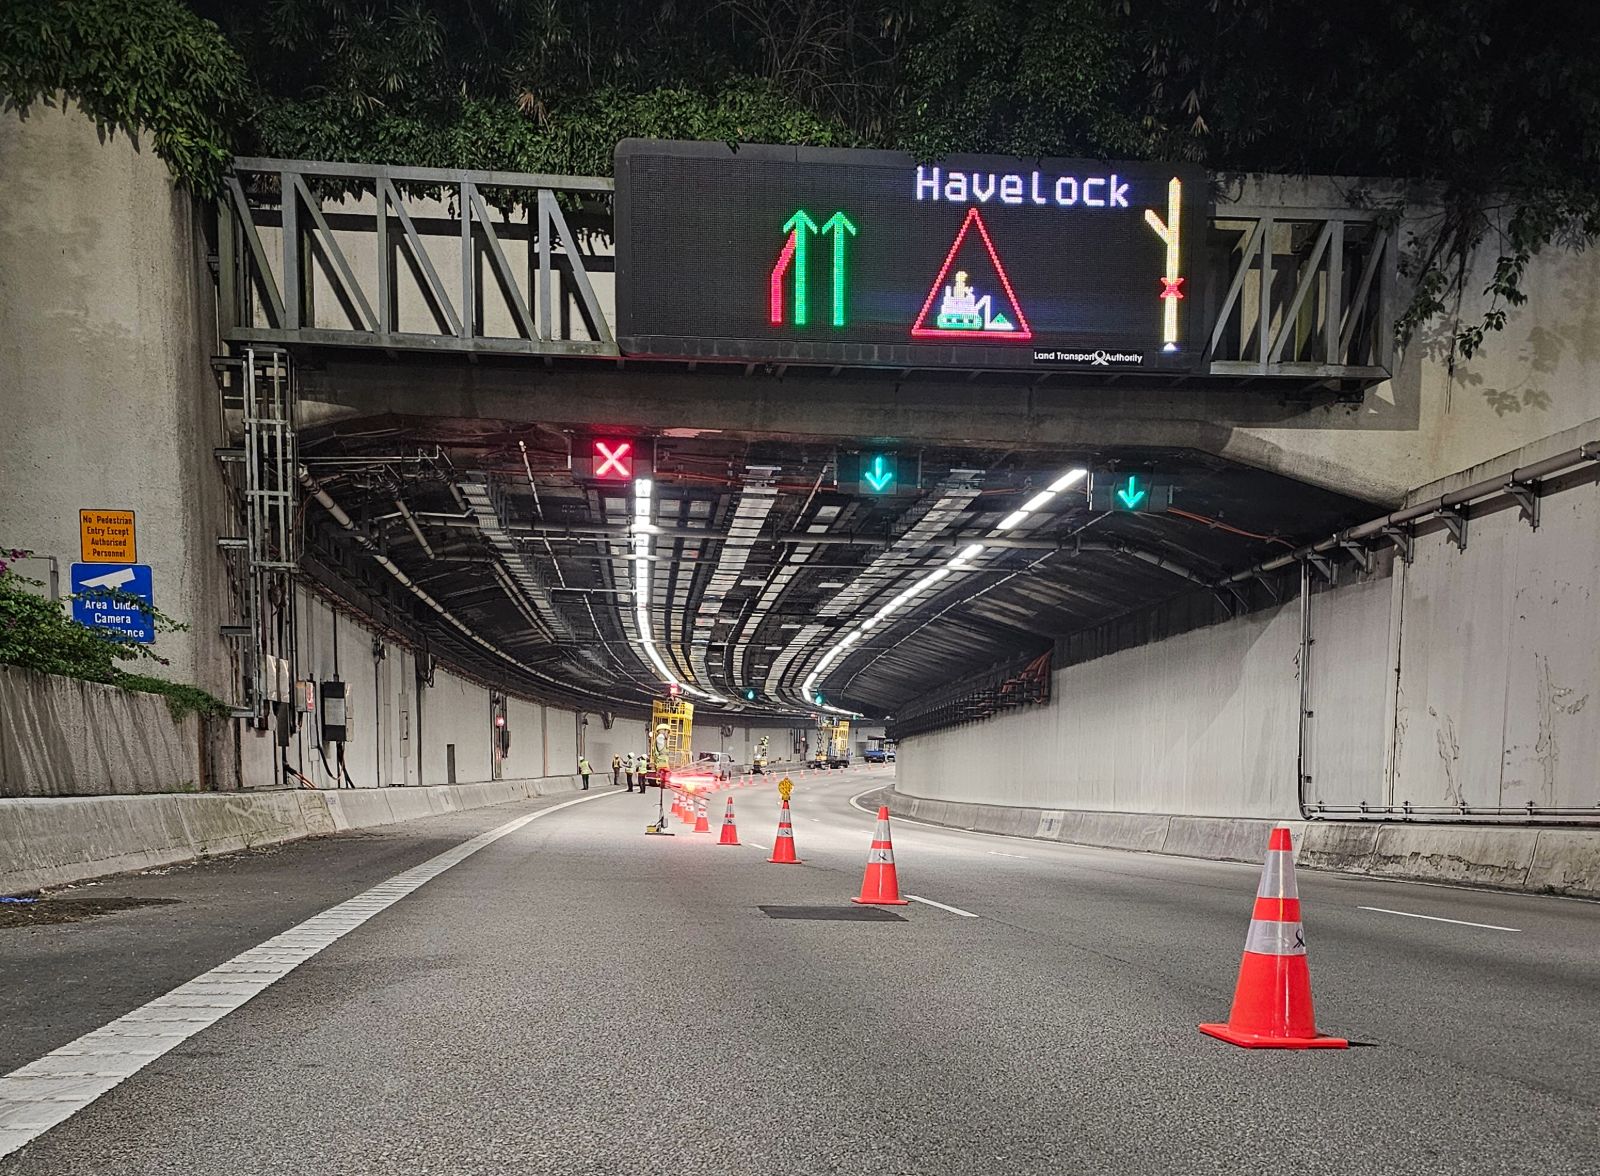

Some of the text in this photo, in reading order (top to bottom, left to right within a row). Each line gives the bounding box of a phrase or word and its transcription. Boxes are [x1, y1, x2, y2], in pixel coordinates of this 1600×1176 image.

[915, 164, 1130, 208] Havelock
[1034, 351, 1143, 364] Land Transport Authority
[83, 515, 132, 525] No Pedestrian
[87, 526, 129, 537] Entry Except
[91, 537, 127, 546] Authorised
[93, 548, 126, 557] Personnel
[85, 600, 108, 609] Area
[94, 612, 131, 623] Camera
